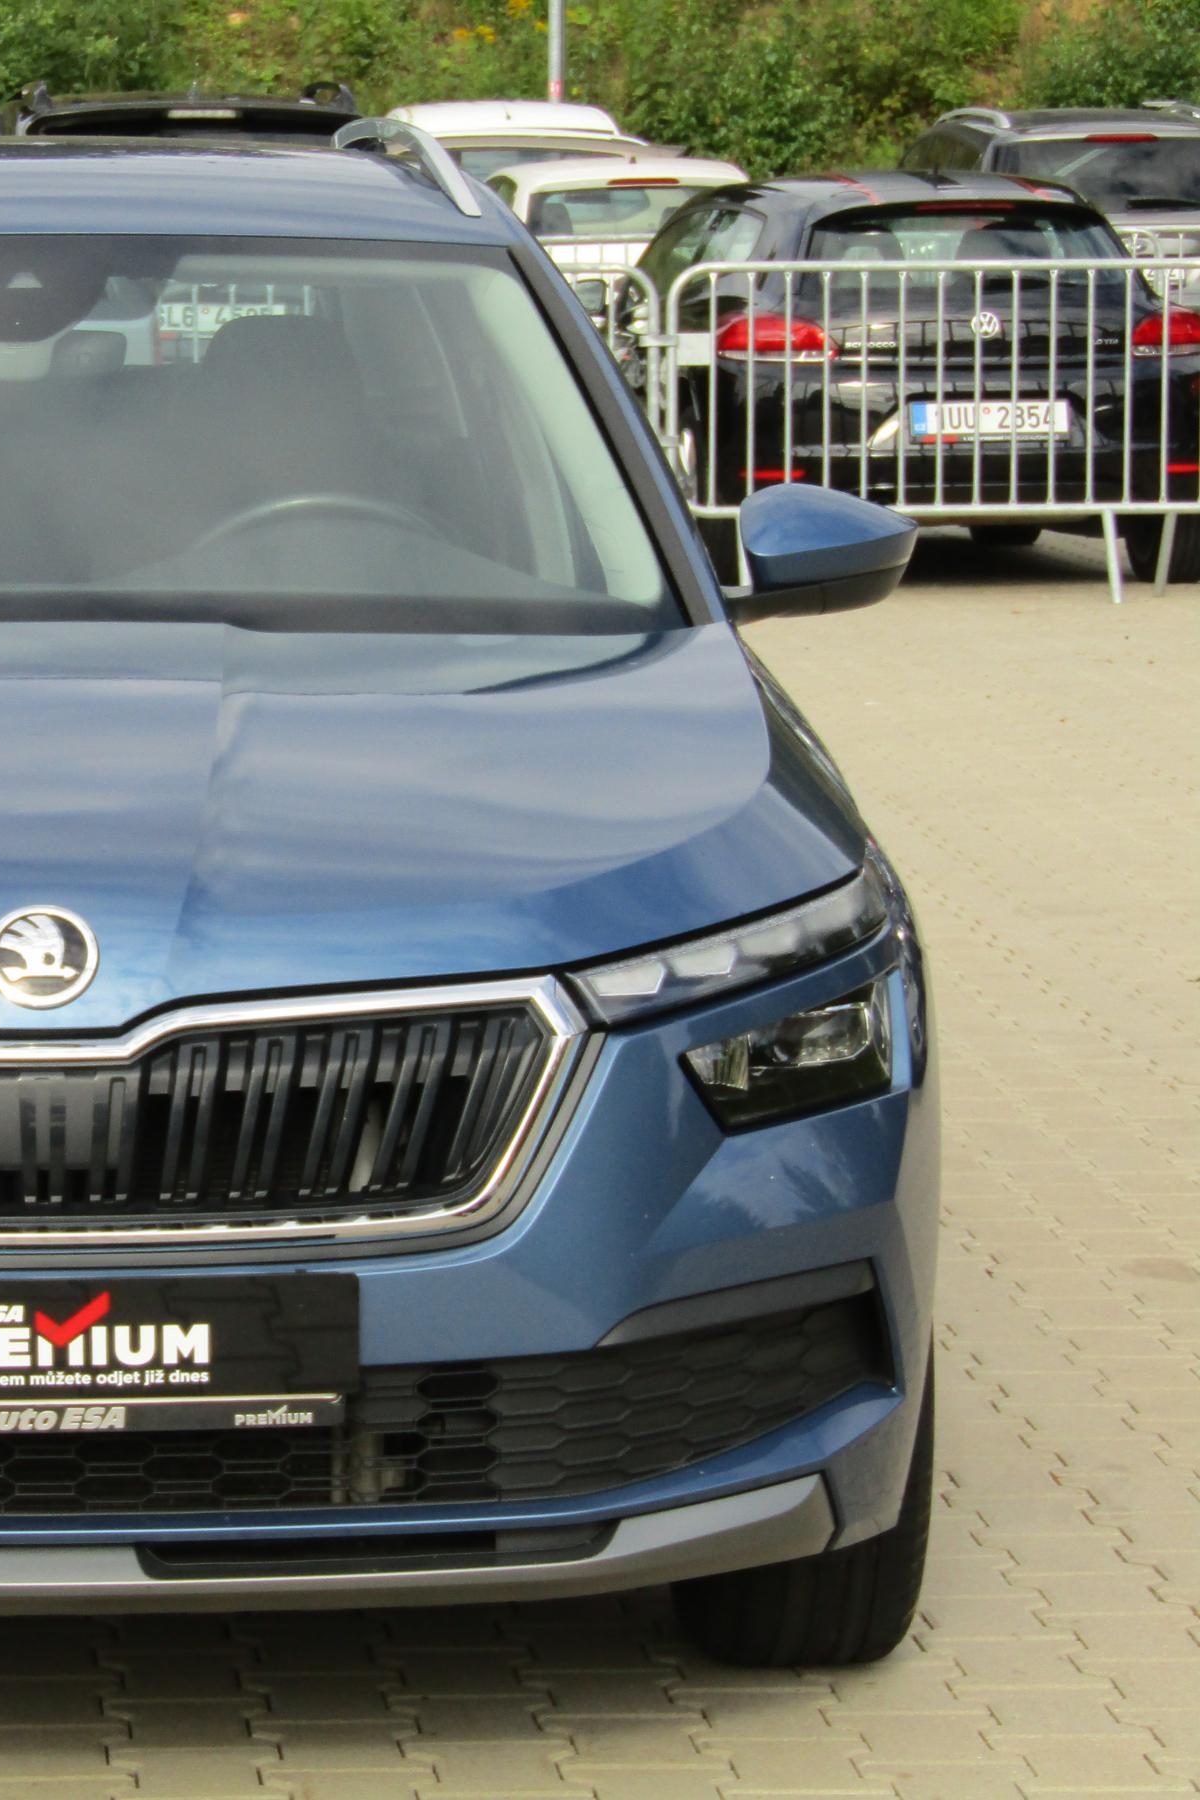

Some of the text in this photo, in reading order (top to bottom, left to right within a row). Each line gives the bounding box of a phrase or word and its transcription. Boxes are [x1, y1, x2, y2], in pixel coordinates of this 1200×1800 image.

[29, 1371, 91, 1386] můžete
[96, 1370, 141, 1388] odjet
[143, 1370, 164, 1387] již
[168, 1369, 209, 1385] dnes
[234, 1404, 313, 1426] PREMIUM
